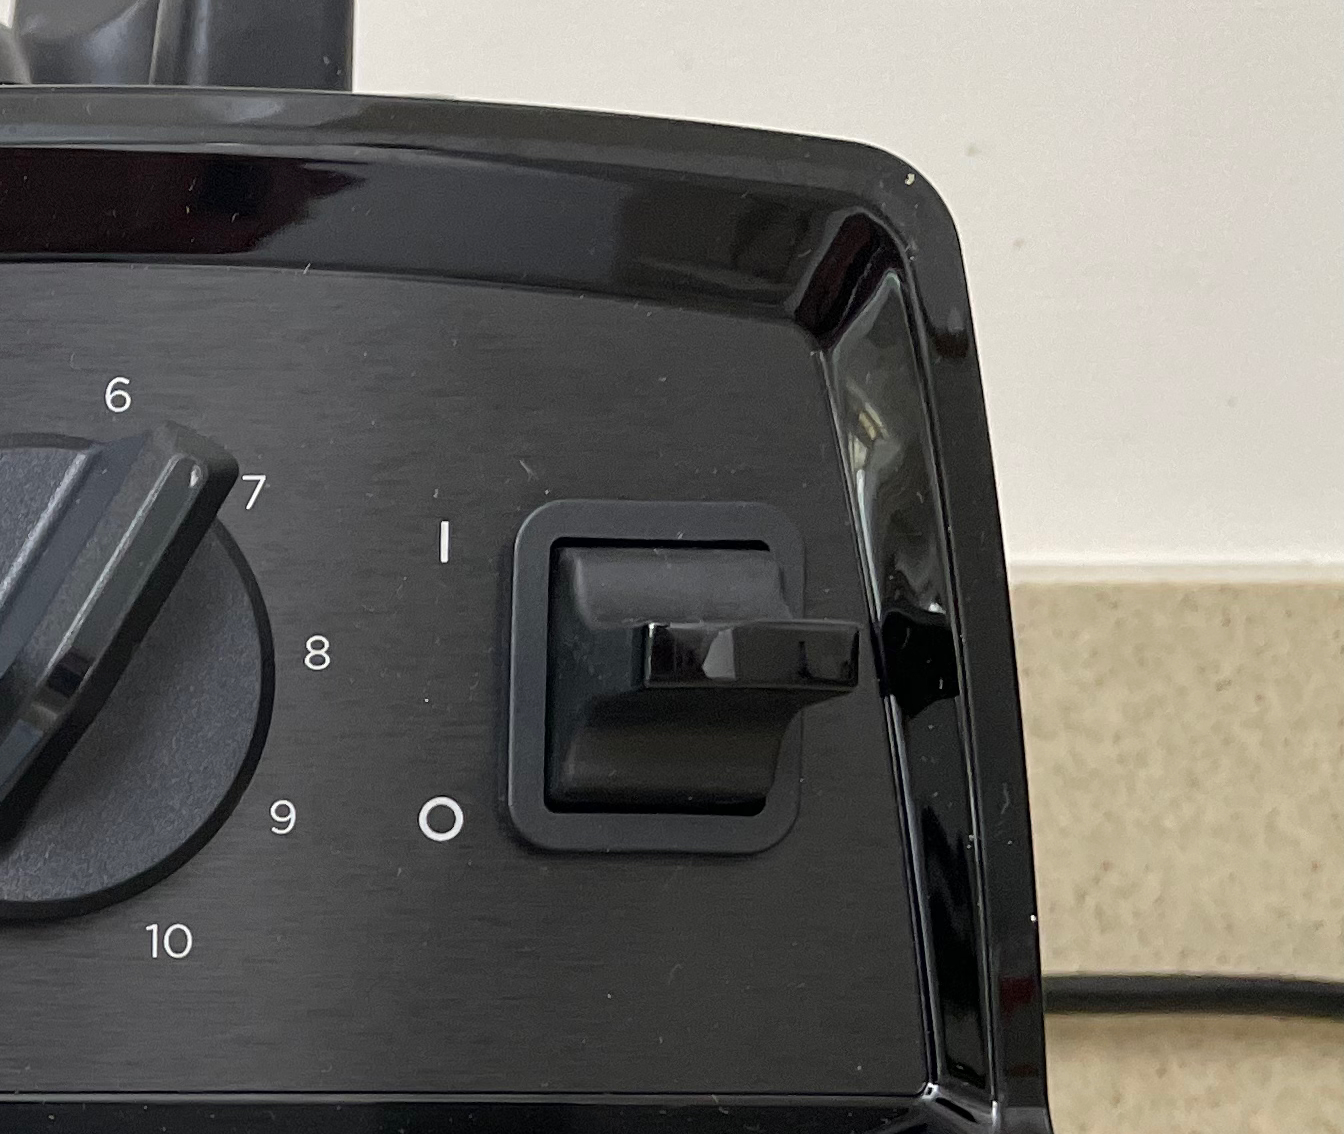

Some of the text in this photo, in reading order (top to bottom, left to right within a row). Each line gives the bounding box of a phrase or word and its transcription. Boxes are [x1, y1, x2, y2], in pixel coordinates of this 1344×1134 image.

[104, 376, 132, 413] 6
[241, 474, 267, 510] 7
[304, 635, 331, 671] 8
[270, 799, 297, 835] 9
[145, 923, 193, 959] 10
